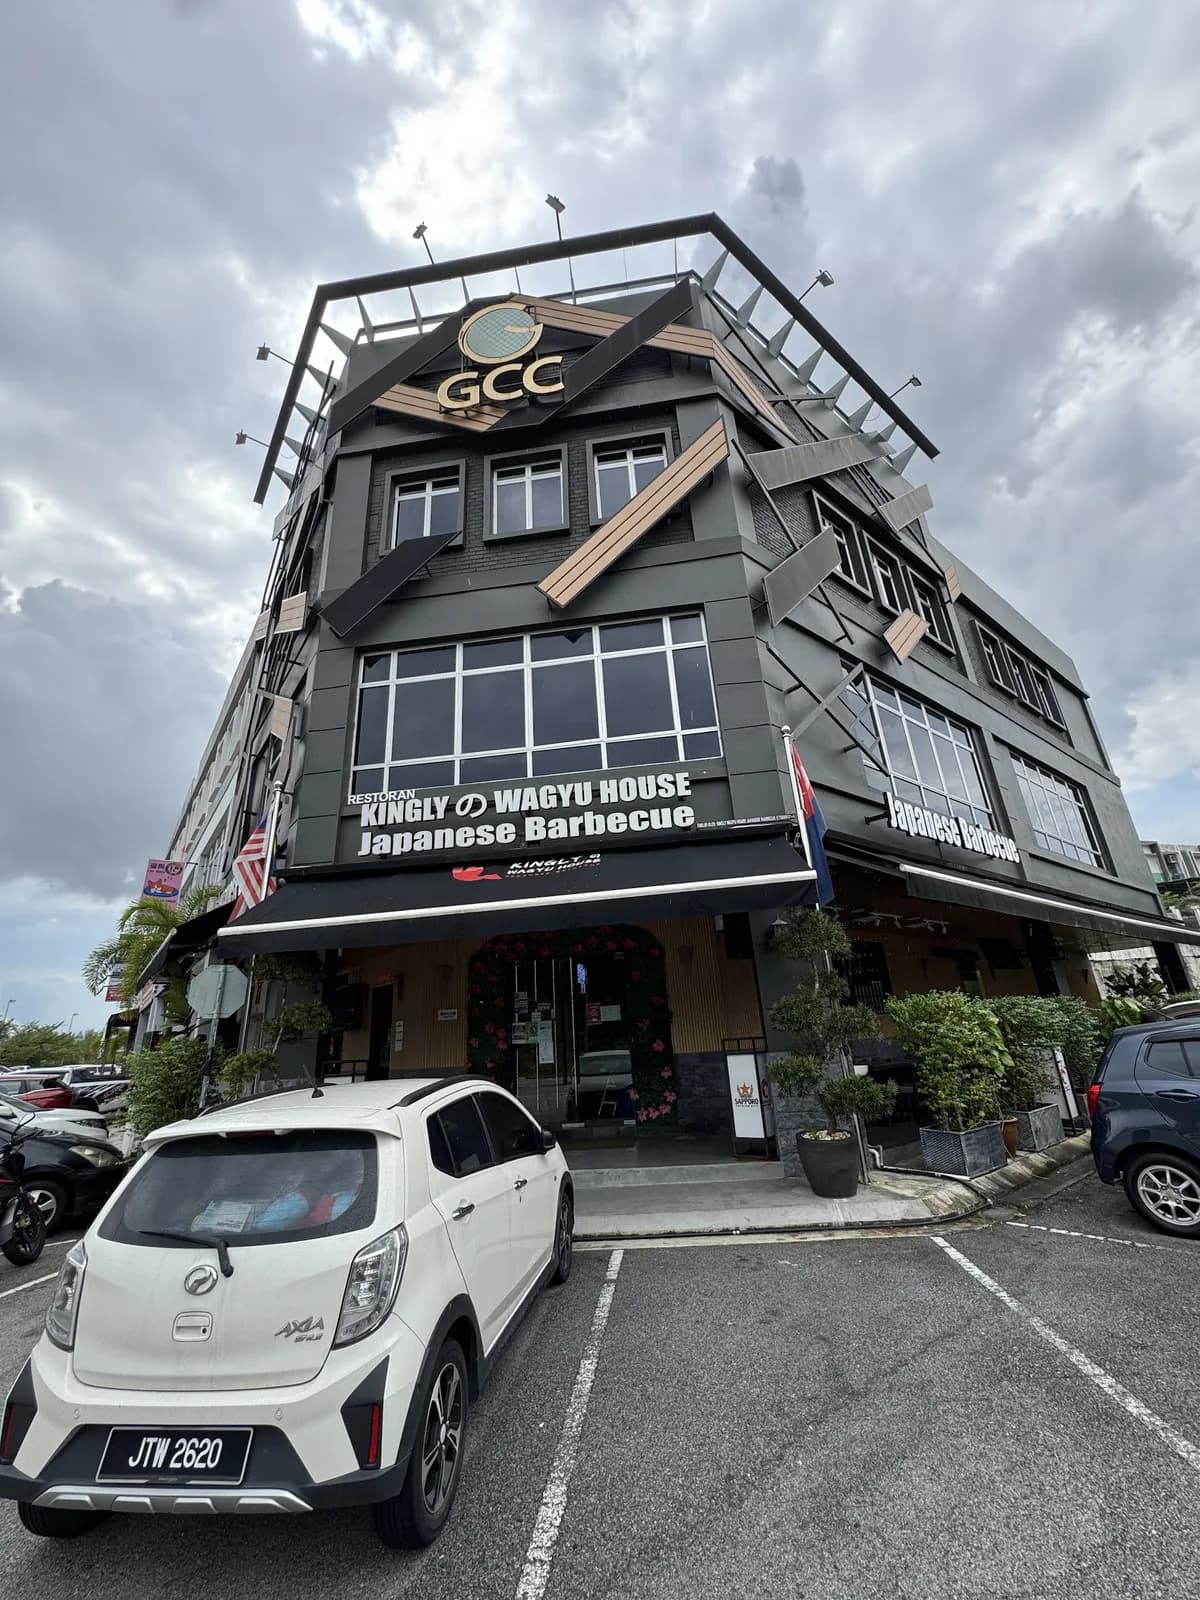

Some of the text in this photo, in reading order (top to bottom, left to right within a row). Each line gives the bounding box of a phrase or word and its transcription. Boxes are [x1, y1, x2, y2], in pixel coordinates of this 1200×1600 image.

[437, 356, 565, 409] GCC
[347, 789, 416, 805] RESTORAN
[360, 772, 692, 827] KINGLY の WAGYU HOUSE
[357, 805, 695, 857] Japanese Barbecue
[886, 791, 1020, 864] Japanese Barbecue
[507, 866, 555, 875] WAGYU
[509, 855, 583, 869] KINGLY
[274, 1316, 325, 1338] AXIA
[128, 1437, 223, 1469] JTW 2620
